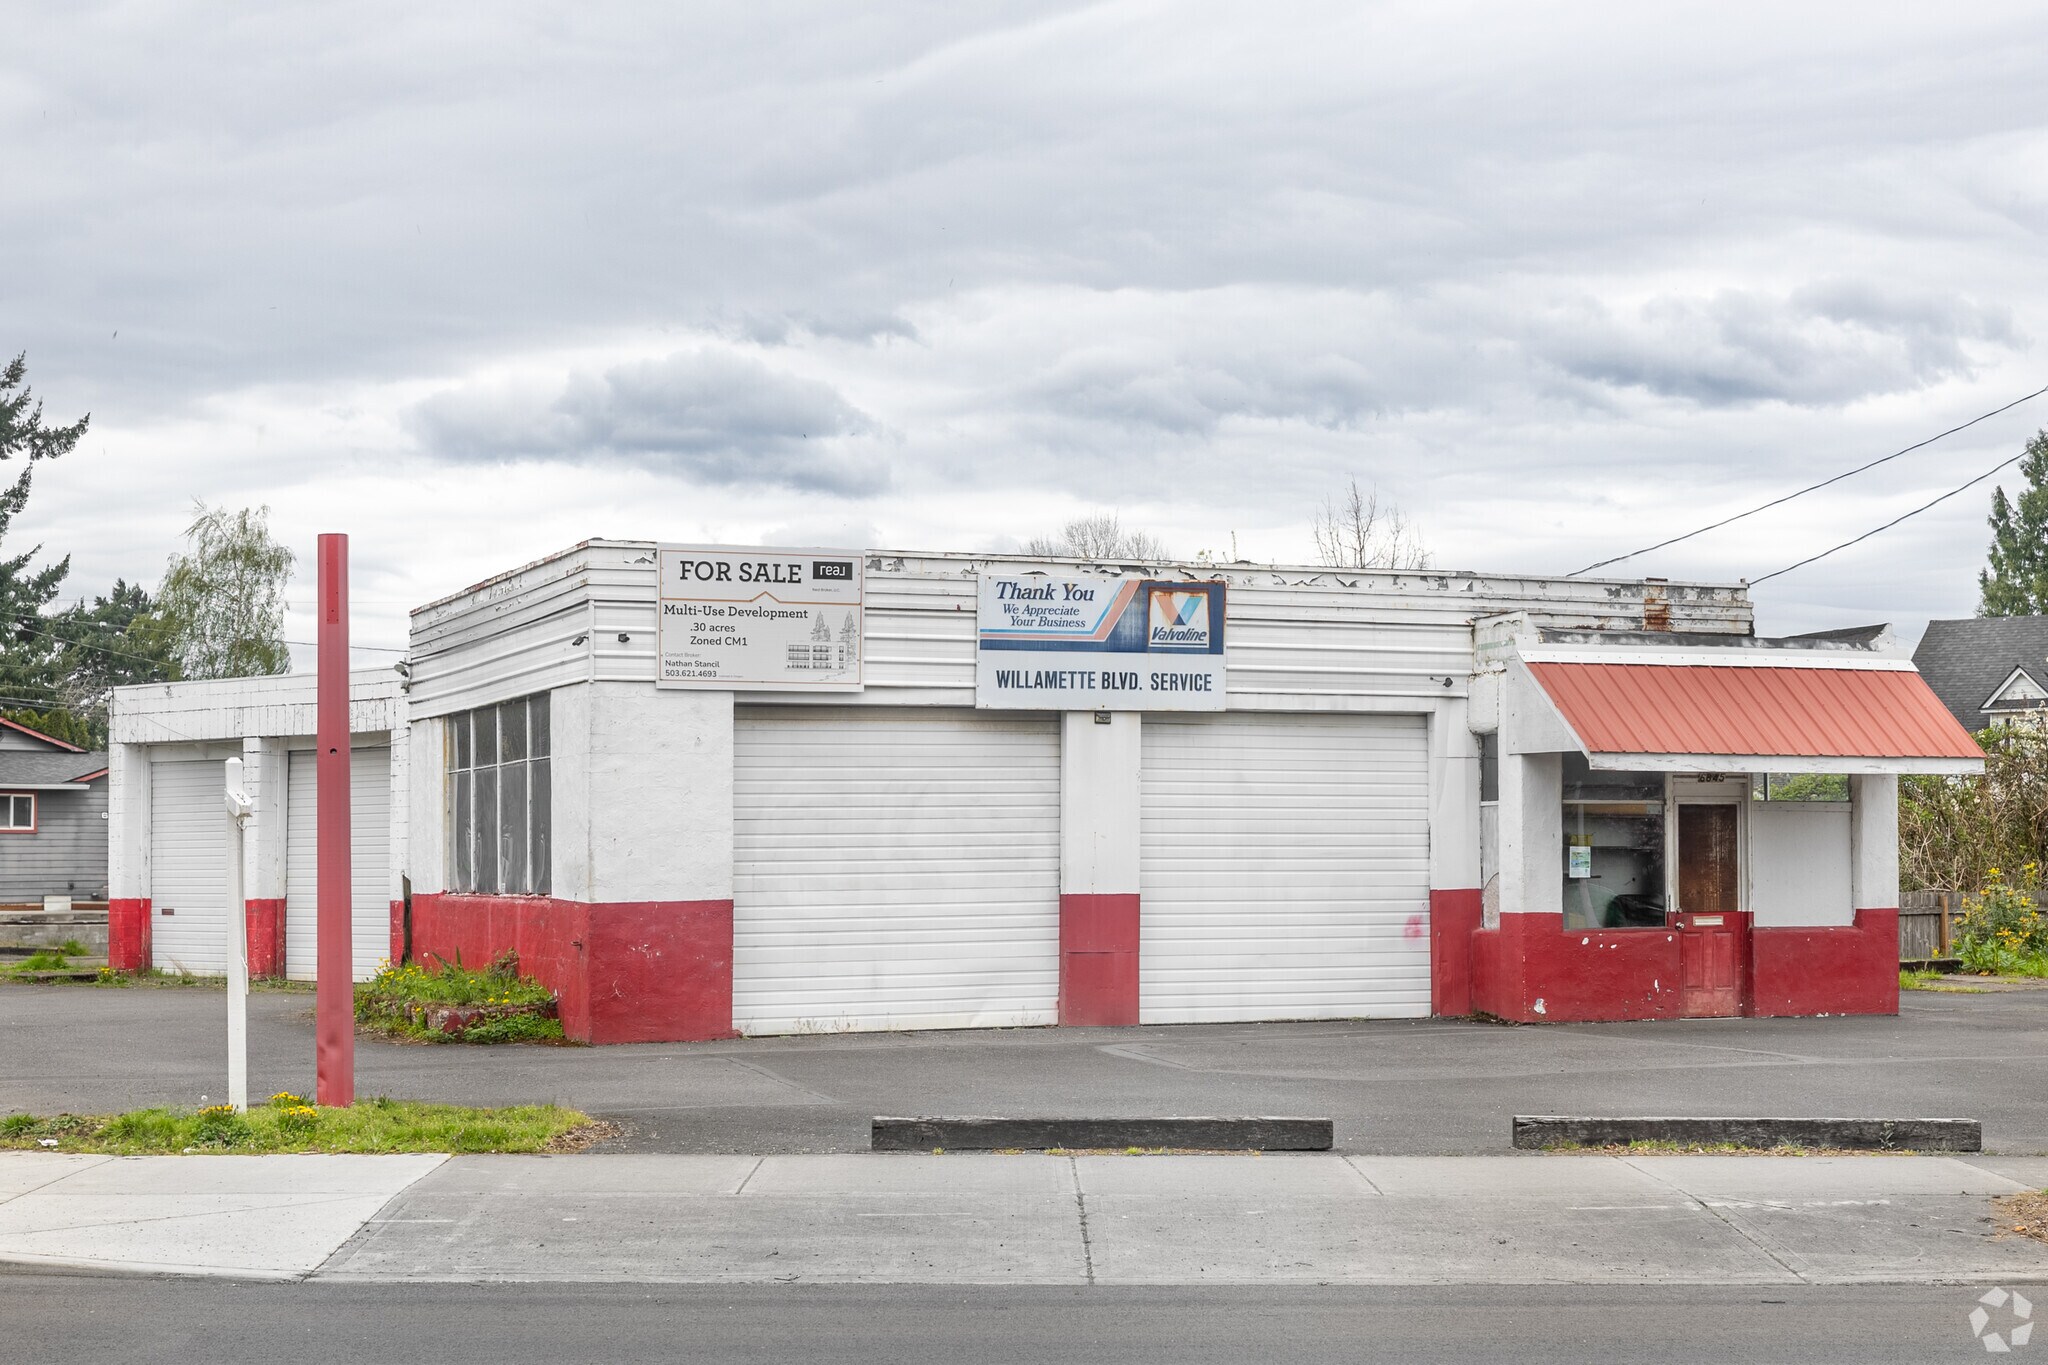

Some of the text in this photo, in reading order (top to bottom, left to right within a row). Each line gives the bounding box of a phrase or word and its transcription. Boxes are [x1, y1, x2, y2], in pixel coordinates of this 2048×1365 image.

[679, 560, 802, 584] FOR SALE
[996, 581, 1095, 602] Thank You
[663, 604, 808, 620] Multi-Use Development
[1003, 603, 1080, 616] We Appreciate
[690, 622, 736, 633] .30 acres
[1010, 615, 1086, 628] Your Business
[1151, 626, 1208, 642] Valvoline
[690, 636, 748, 646] Zoned CM1
[665, 660, 720, 668] Nathan Stancil
[665, 669, 717, 678] 503.621.4693
[996, 670, 1213, 692] WILLAMETTE BLVD. SERVICE
